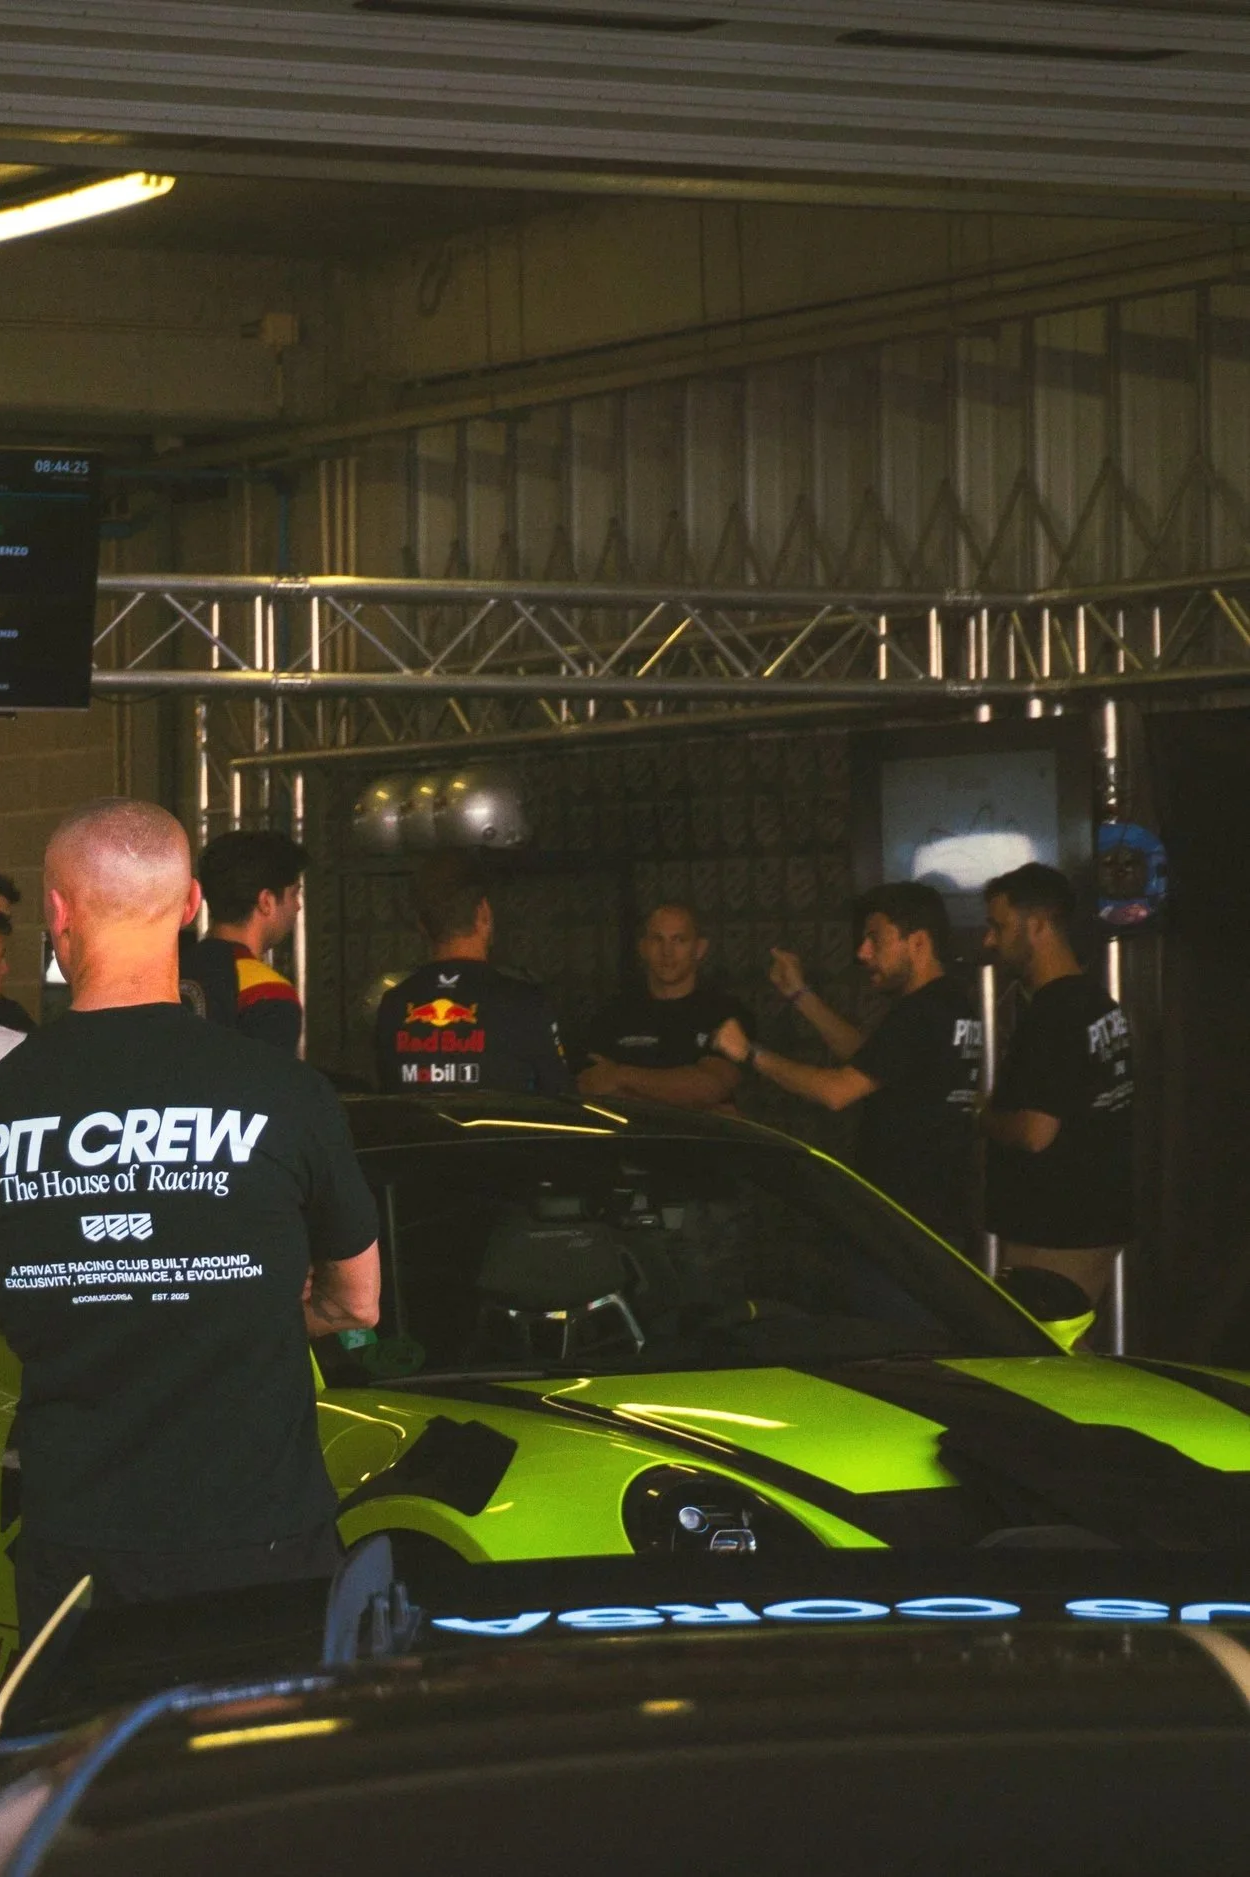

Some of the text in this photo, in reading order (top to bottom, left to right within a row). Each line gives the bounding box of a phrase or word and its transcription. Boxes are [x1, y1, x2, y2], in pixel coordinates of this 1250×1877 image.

[34, 459, 89, 474] 08:44:25
[396, 1029, 485, 1053] Red Bull
[402, 1063, 455, 1083] Mobil
[68, 1107, 268, 1167] CREW
[0, 1164, 229, 1203] The House of Racing
[5, 1265, 263, 1289] EXCLUSIVITY, PERFORMANCE, & EVOLUTION
[10, 1253, 250, 1278] A PRIVATE RACING CLUB BUILT AROUND
[72, 1292, 190, 1304] @DOMUSCORSA EST. 2025
[430, 1597, 1021, 1637] CORSA
